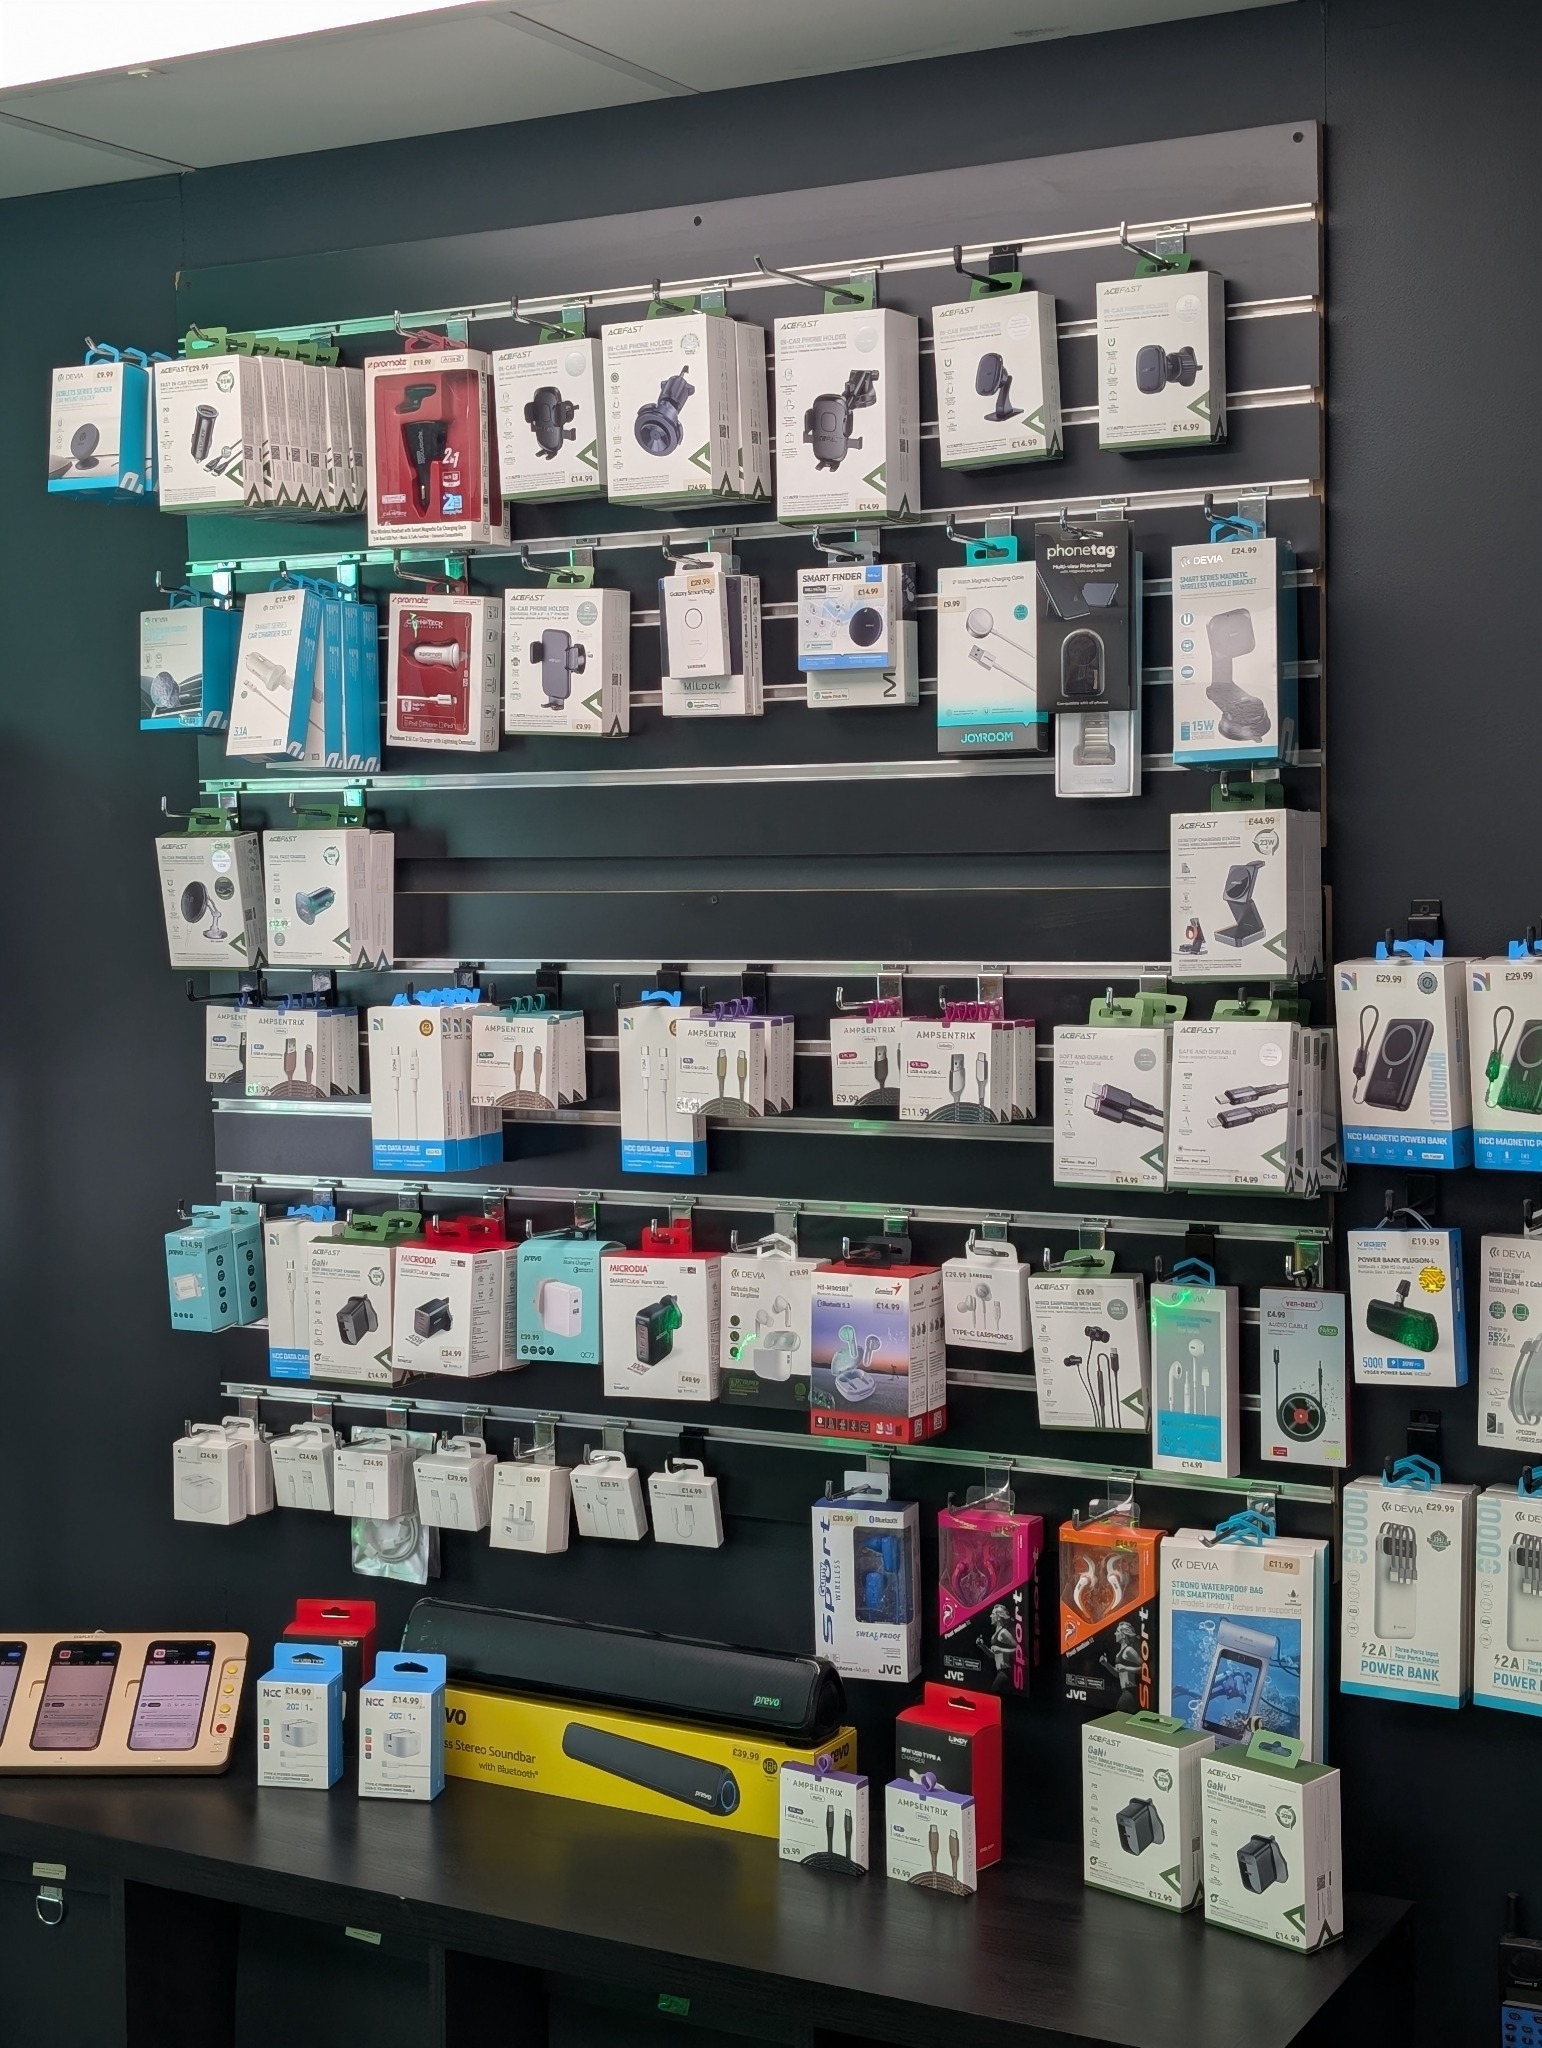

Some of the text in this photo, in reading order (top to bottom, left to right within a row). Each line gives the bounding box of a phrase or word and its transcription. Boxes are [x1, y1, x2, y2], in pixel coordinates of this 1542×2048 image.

[1104, 285, 1143, 295] ACEFAST
[939, 306, 975, 317] ACEFAST
[780, 320, 819, 330] ACEFAST
[607, 325, 643, 336] ACEFAST
[498, 351, 532, 361] ACEFAST
[189, 364, 209, 372] £29.99
[373, 359, 407, 368] promate
[160, 366, 189, 374] ACEFAST
[1173, 423, 1199, 432] £14.99
[1012, 439, 1037, 448] £14.99
[571, 475, 593, 483] £14.99
[1047, 544, 1116, 560] phonetag
[1193, 556, 1223, 565] DEVIA
[803, 572, 862, 582] SMART FINDER
[1180, 572, 1248, 584] SMART SERIES MAGNETIC
[1180, 578, 1257, 590] WIRELESS VEHICLE BRACKET
[857, 587, 879, 596] £14.99
[943, 600, 960, 608] £9.99
[1192, 720, 1214, 731] 15W
[961, 731, 1013, 743] JOYROOM
[1178, 821, 1218, 830] ACEFAST
[1249, 817, 1275, 825] £44.99
[1376, 974, 1402, 984] £29.99
[1505, 972, 1533, 981] £29.99
[258, 1018, 305, 1026] AMPSENTRIX
[485, 1025, 535, 1033] AMPSENTRIX
[688, 1029, 737, 1038] AMPSENTRIX
[844, 1026, 896, 1034] AMPSENTRIX
[1180, 1026, 1221, 1034] ACEFAST
[916, 1031, 976, 1039] AMPSENTRIX
[1428, 1052, 1449, 1125] 10000mAh
[472, 1096, 495, 1105] £11.99
[837, 1094, 858, 1102] £9.99
[902, 1108, 929, 1117] £11.99
[1363, 1134, 1399, 1143] MAGNETIC
[1400, 1136, 1425, 1144] POWER
[1427, 1137, 1447, 1145] BANK
[1479, 1137, 1535, 1147] NCC MAGNETIC
[1116, 1175, 1138, 1184] £14.99
[1235, 1175, 1258, 1184] £14.99
[181, 1240, 202, 1249] £14.99
[1412, 1238, 1440, 1246] £19.99
[1503, 1250, 1531, 1259] DEVIA
[400, 1255, 437, 1265] MICRODIA
[609, 1264, 648, 1273] MICRODIA
[1077, 1288, 1094, 1296] £9.99
[876, 1302, 900, 1311] £14.99
[1289, 1322, 1308, 1330] CABLE
[952, 1329, 1013, 1341] TYPE-C EARPHONES
[1488, 1332, 1506, 1342] 55%
[1363, 1357, 1383, 1368] 5000
[363, 1459, 383, 1467] £24.99
[1395, 1504, 1423, 1514] DEVIA
[1426, 1503, 1455, 1513] £29.99
[1186, 1561, 1219, 1571] DEVIA
[1269, 1561, 1293, 1570] £11.99
[820, 1516, 836, 1645] Sport
[1172, 1581, 1263, 1594] STRONG WATERPROOF BAG
[1172, 1589, 1235, 1601] FOR SMARTPHONE
[856, 1631, 901, 1641] SWEAT PROOF
[1013, 1590, 1024, 1691] Sport
[1369, 1643, 1387, 1657] 2A
[1395, 1646, 1439, 1657] Three Ports Input
[1138, 1606, 1150, 1710] Sport
[1395, 1653, 1439, 1665] Four Ports Output
[1501, 1656, 1519, 1669] 2A
[878, 1664, 901, 1675] JVC
[1361, 1660, 1439, 1682] POWER BANK
[944, 1671, 964, 1681] JVC
[1493, 1671, 1537, 1689] POWER
[263, 1689, 282, 1698] NCC
[285, 1687, 311, 1696] £14.99
[1066, 1690, 1086, 1701] JVC
[365, 1698, 384, 1706] NCC
[392, 1696, 419, 1705] £14.99
[753, 1695, 780, 1709] prevo
[1088, 1734, 1121, 1747] ACEFAST
[455, 1740, 536, 1764] Stereo Soundbar
[732, 1747, 760, 1761] £39.99
[901, 1754, 925, 1764] CHARGER
[1207, 1768, 1242, 1782] ACEFAST
[793, 1779, 843, 1798] AMPSENTRIX
[695, 1790, 712, 1801] prevo
[898, 1798, 948, 1817] AMPSENTRIX
[1233, 1795, 1245, 1803] PORT
[1245, 1798, 1266, 1810] CHARGER
[783, 1847, 800, 1855] £9.99
[892, 1867, 910, 1877] £9.99
[1149, 1890, 1172, 1903] £12.99
[1276, 1931, 1300, 1943] £14.99
